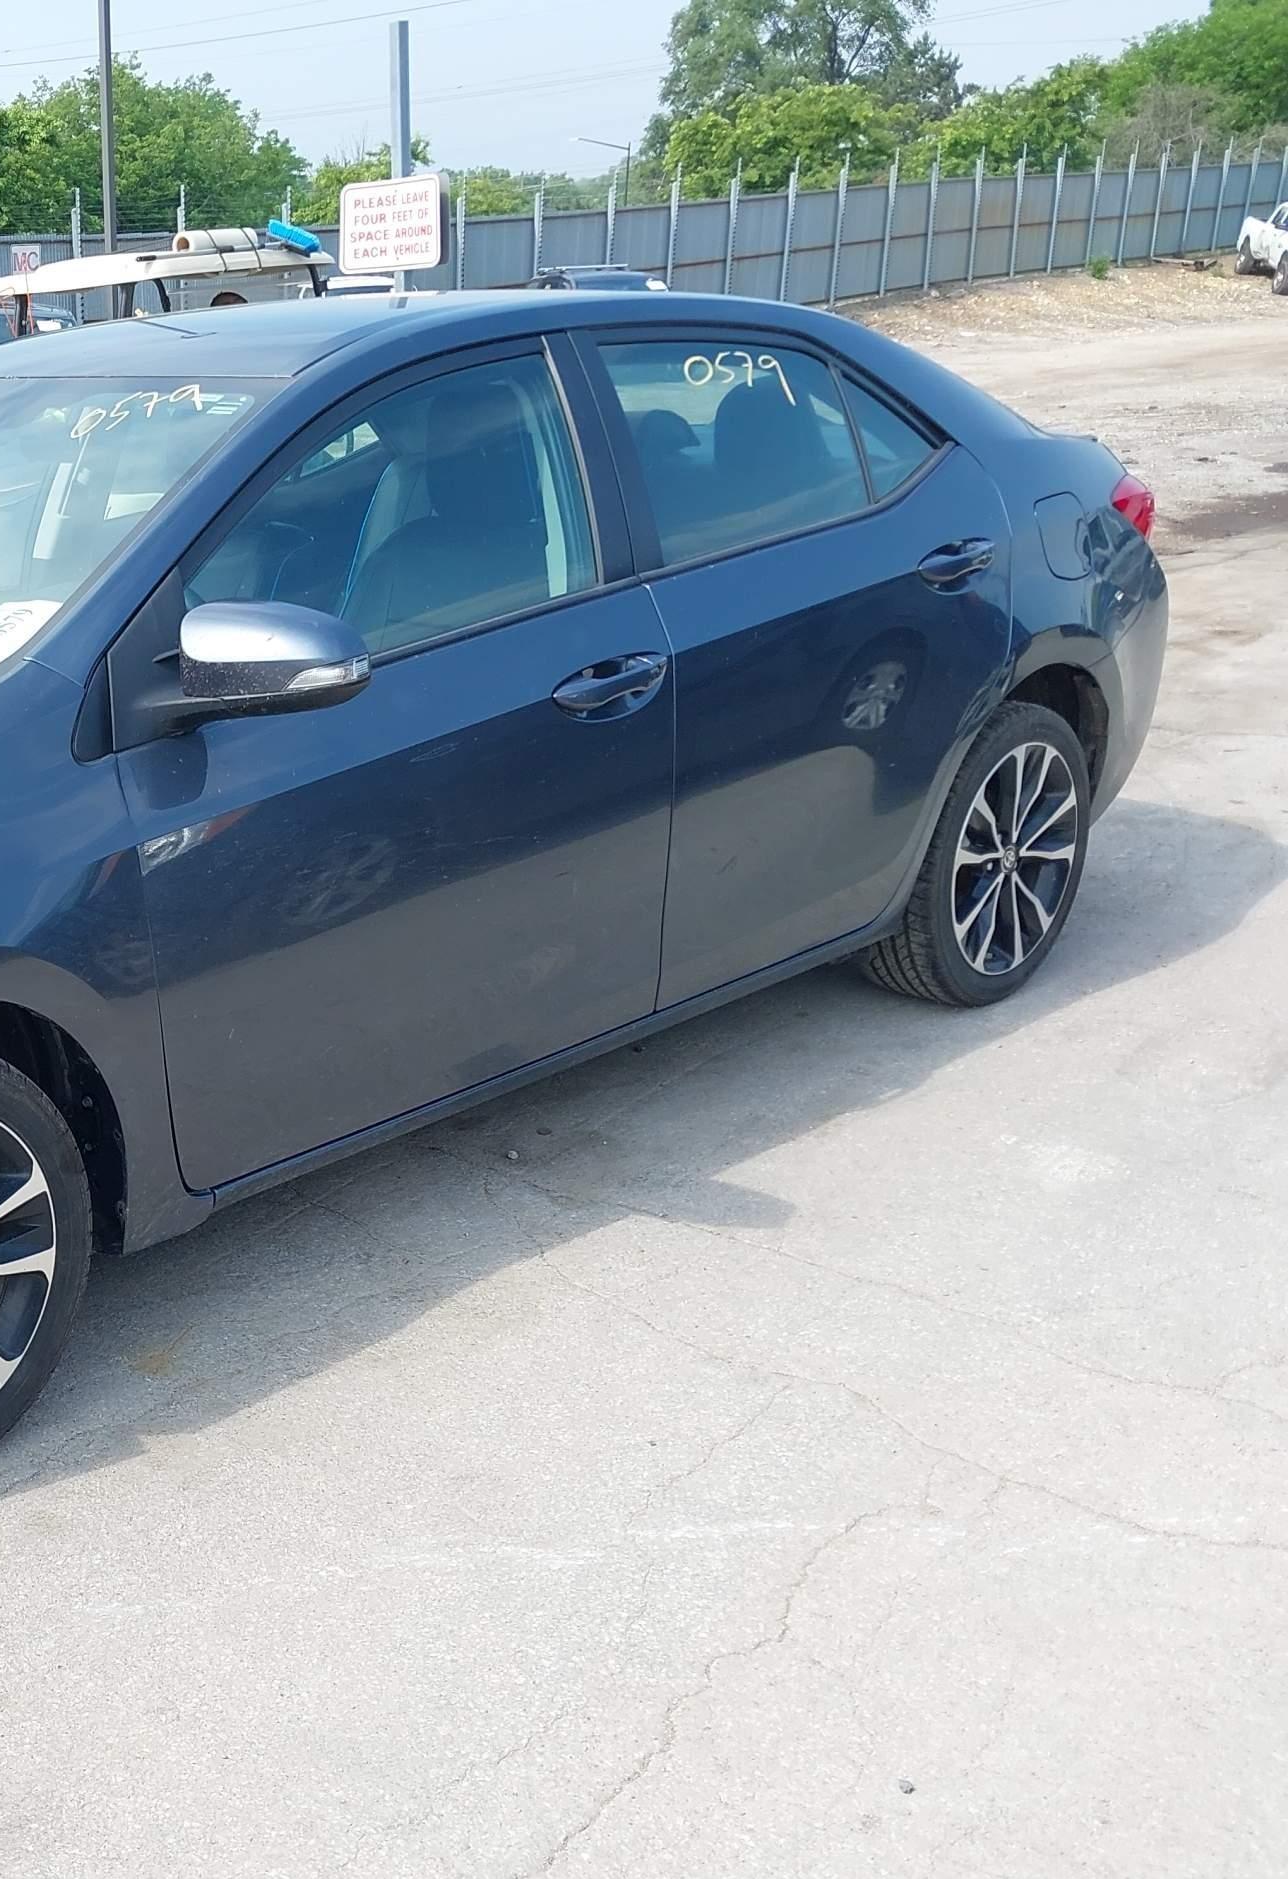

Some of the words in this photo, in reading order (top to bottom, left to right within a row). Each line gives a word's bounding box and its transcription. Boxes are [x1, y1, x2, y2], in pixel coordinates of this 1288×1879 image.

[353, 195, 397, 209] PLEASE
[401, 190, 429, 204] LEAVE
[354, 213, 387, 226] FOUR
[392, 209, 414, 222] FEET
[417, 207, 429, 219] OF
[350, 229, 391, 243] SPACE
[394, 224, 433, 238] AROUND
[353, 246, 387, 259] EACH
[393, 241, 431, 256] VEHICLE
[13, 251, 39, 272] MC
[683, 351, 797, 406] 0579
[70, 383, 204, 439] 0579
